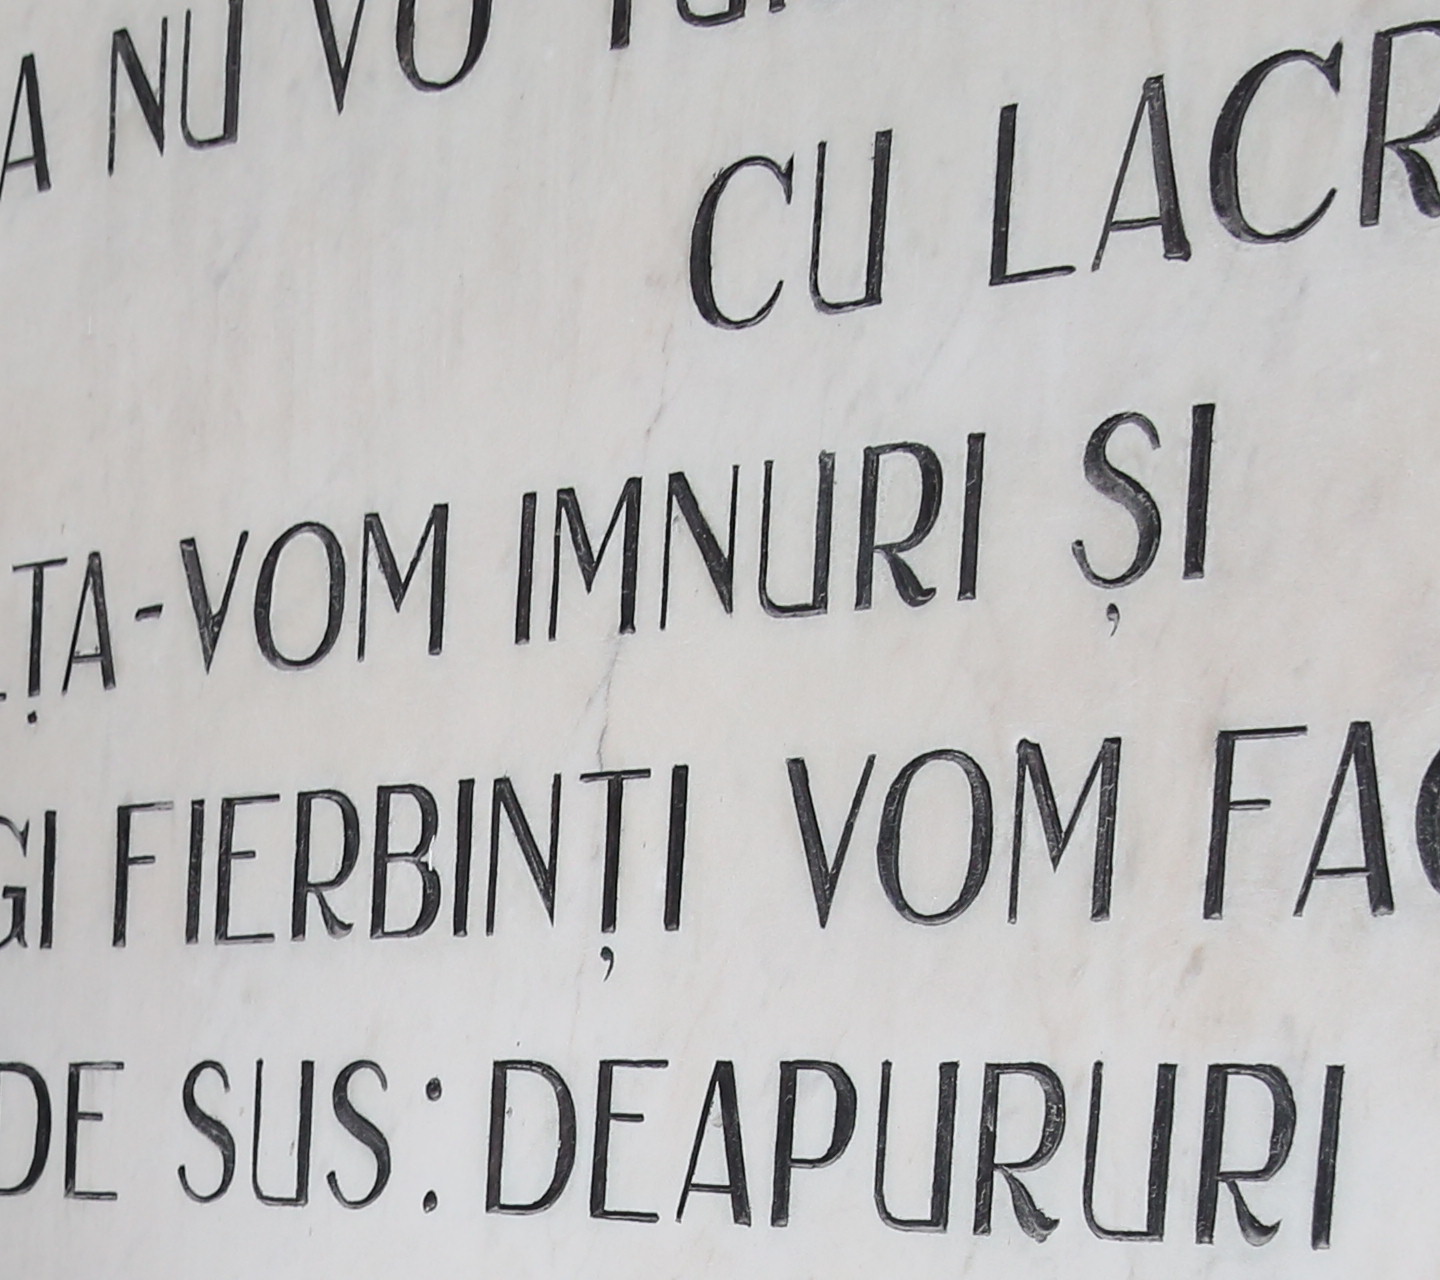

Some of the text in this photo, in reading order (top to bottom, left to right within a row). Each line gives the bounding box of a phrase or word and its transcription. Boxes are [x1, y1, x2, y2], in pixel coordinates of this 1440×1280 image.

[107, 0, 244, 177] NU
[688, 127, 894, 332] CU
[513, 431, 987, 646] IMNURI
[1071, 402, 1217, 638] ȘI
[111, 762, 690, 983] FIERBINȚI
[785, 735, 1123, 930] VOM
[484, 1058, 1346, 1251] DEAPURURI
